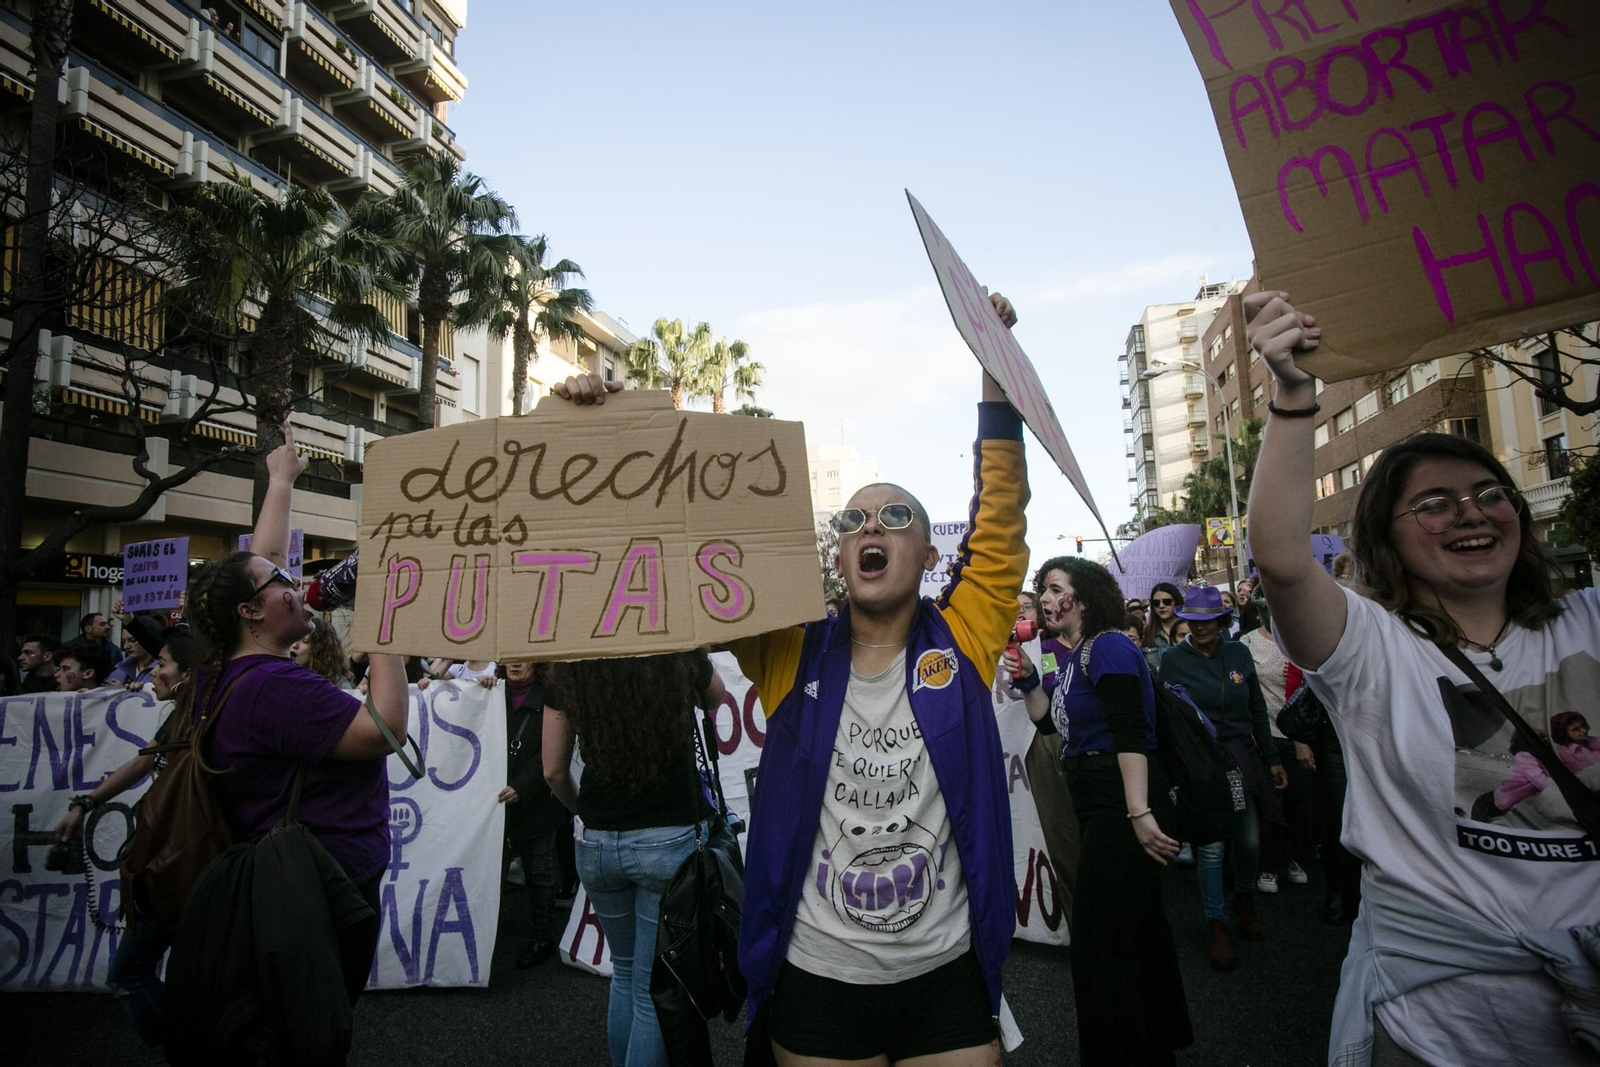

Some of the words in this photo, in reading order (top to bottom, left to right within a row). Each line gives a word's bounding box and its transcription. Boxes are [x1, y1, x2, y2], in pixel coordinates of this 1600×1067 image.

[1229, 0, 1575, 149] ABORTAR
[1277, 80, 1600, 234] MATAR
[400, 417, 787, 508] derechos
[370, 508, 443, 569] pa
[453, 503, 529, 547] las
[933, 523, 969, 536] CUERP
[127, 543, 160, 559] SOMOS
[163, 543, 176, 555] EL
[150, 574, 167, 583] QUE
[377, 537, 755, 645] PUTAS
[917, 655, 957, 686] LAKERS
[849, 720, 923, 754] PORQUE
[833, 747, 845, 768] E
[853, 756, 920, 780] QUIER
[1463, 832, 1512, 854] TOO
[1516, 840, 1583, 860] PURE
